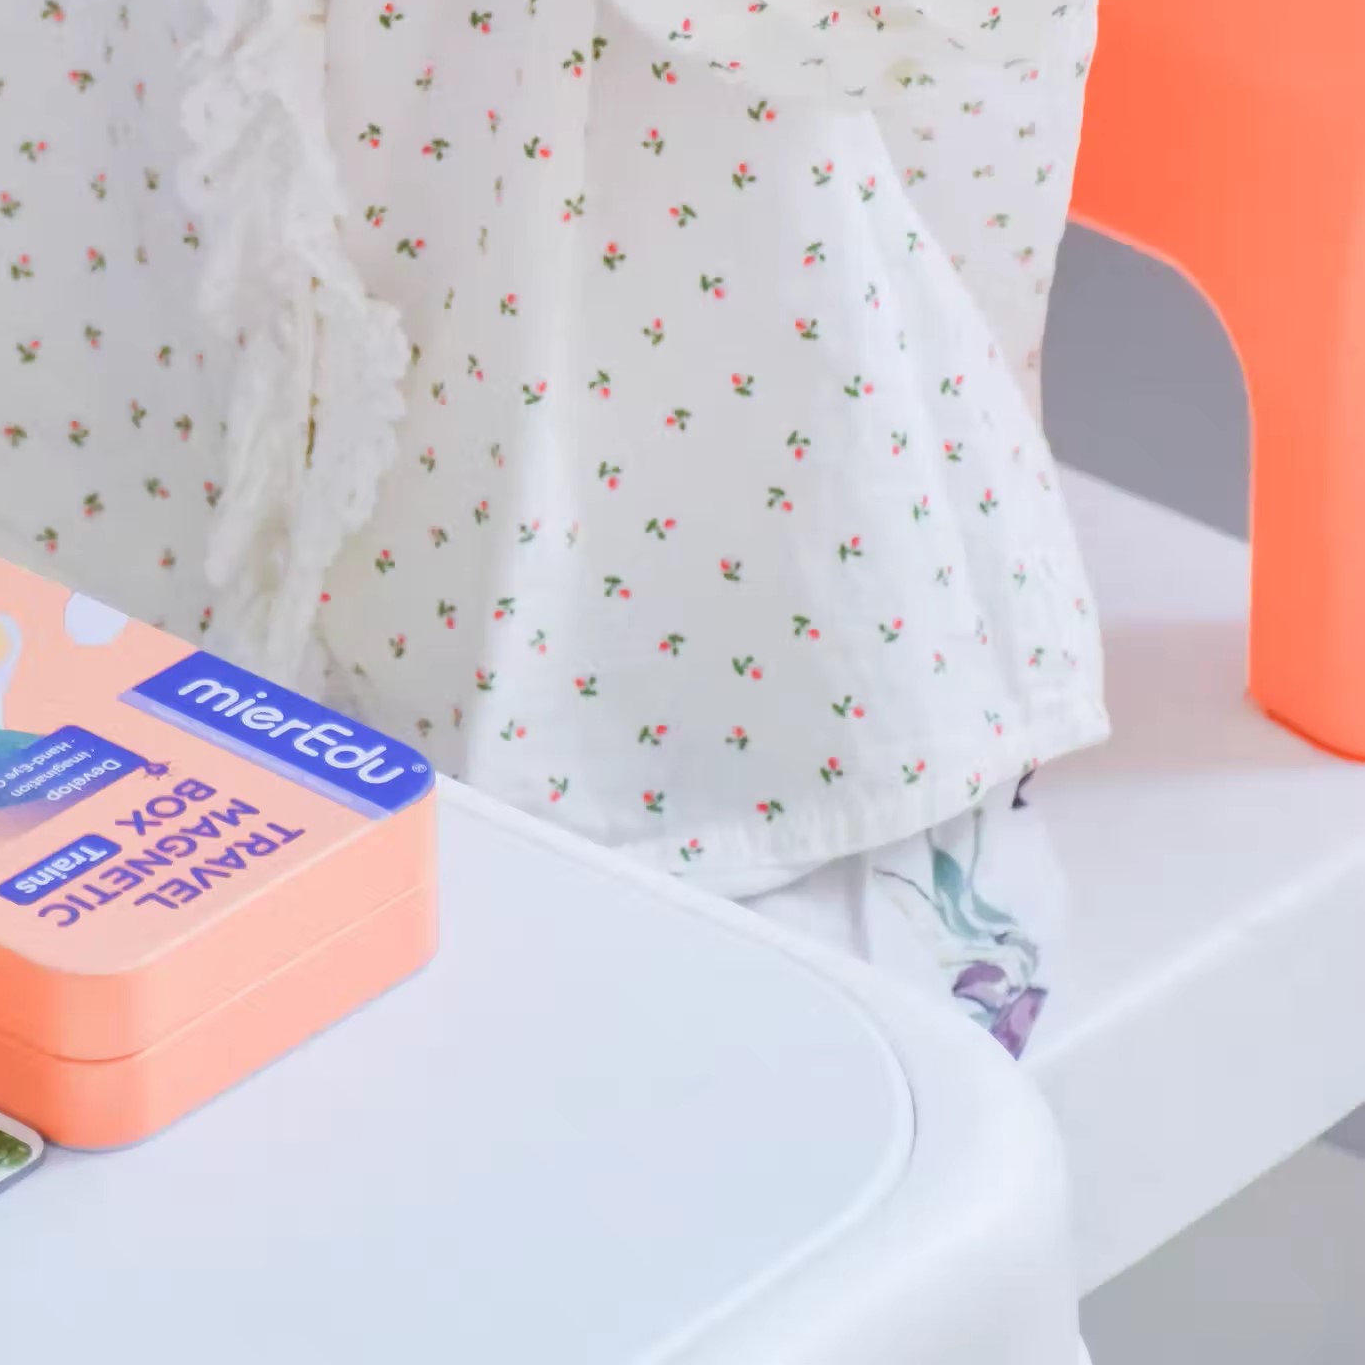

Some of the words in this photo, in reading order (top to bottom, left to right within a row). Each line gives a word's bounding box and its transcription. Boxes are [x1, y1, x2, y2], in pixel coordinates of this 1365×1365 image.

[177, 678, 406, 784] mierEdu
[4, 741, 73, 781] Hand-Eye
[10, 750, 93, 798] Imagination
[46, 758, 123, 802] Develop
[114, 777, 218, 837] BOX
[14, 844, 108, 895] Trains
[37, 798, 261, 928] MAGNETIC
[132, 822, 306, 910] TRAVEL
